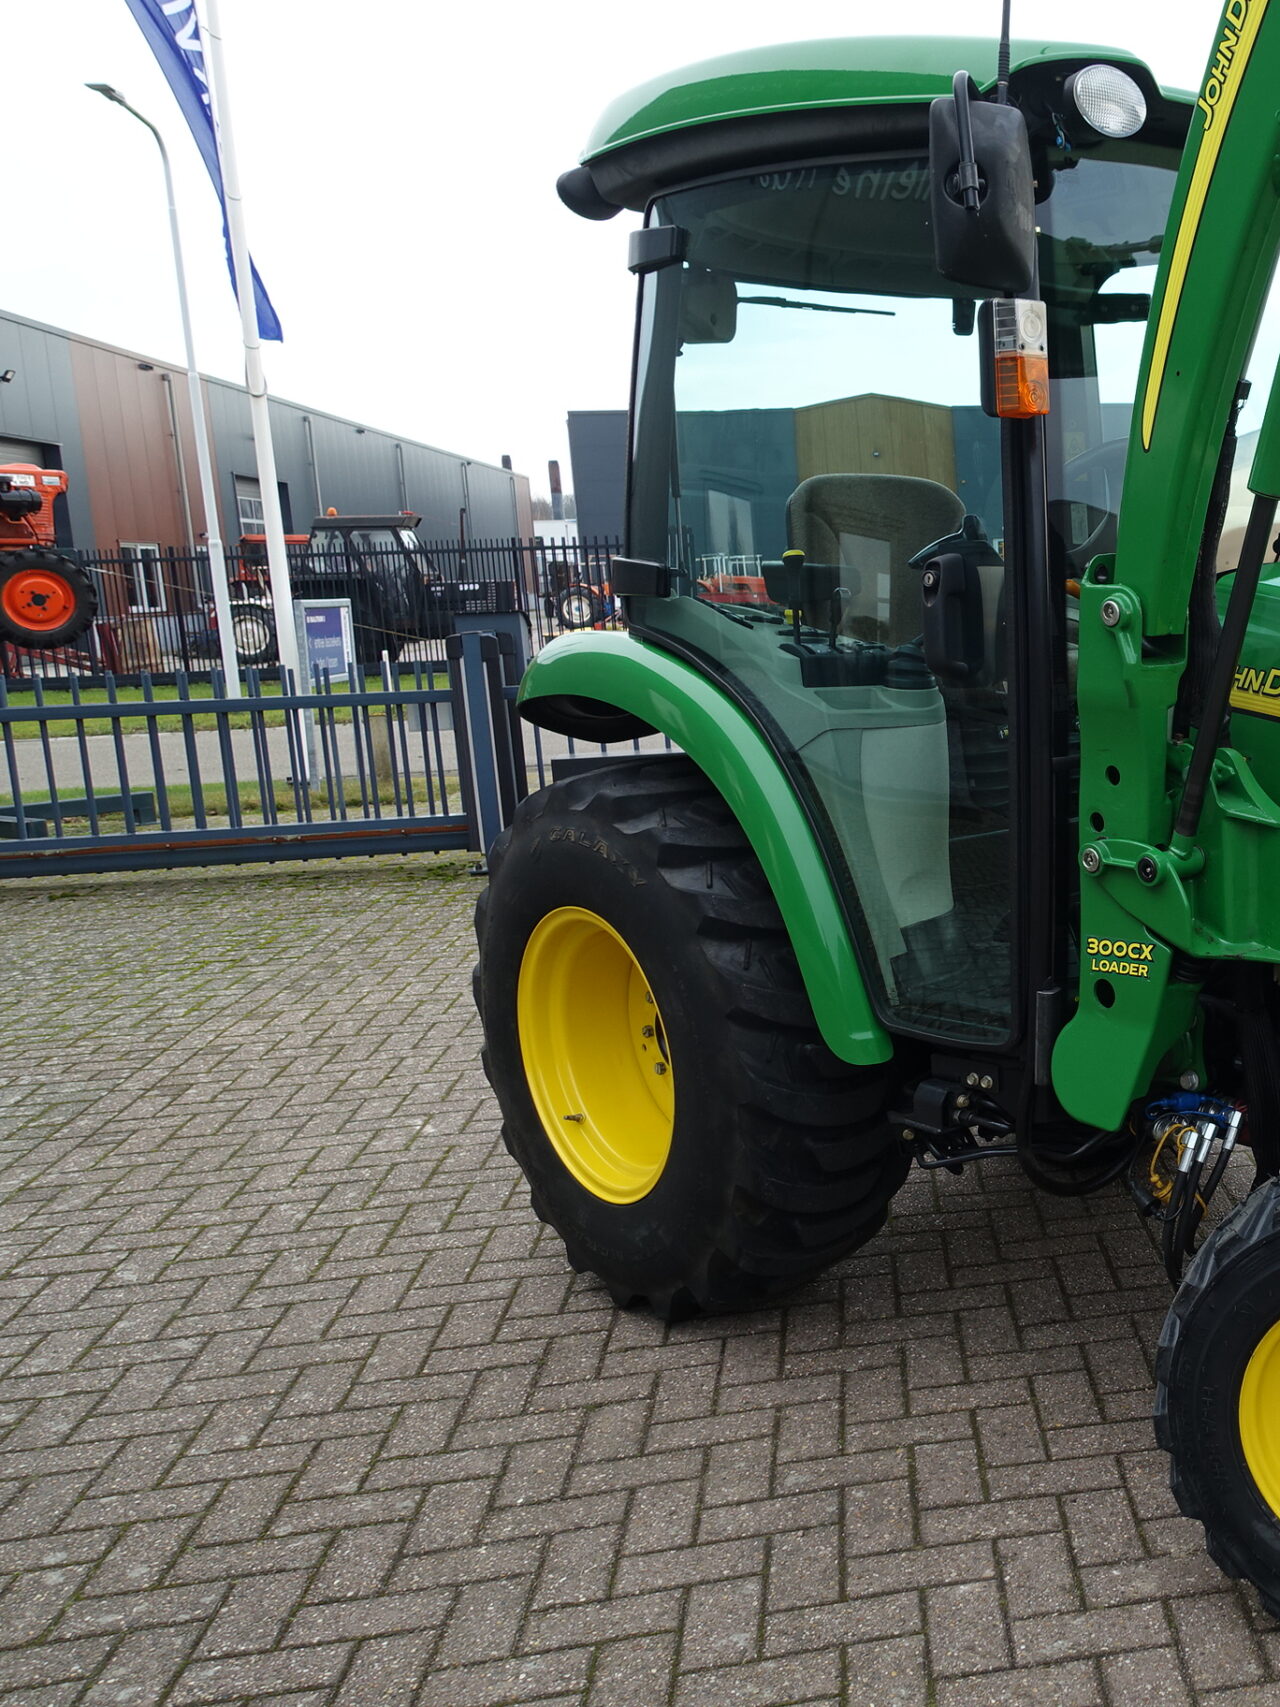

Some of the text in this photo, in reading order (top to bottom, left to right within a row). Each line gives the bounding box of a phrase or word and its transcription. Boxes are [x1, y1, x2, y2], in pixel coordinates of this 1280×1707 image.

[1197, 27, 1238, 131] JOHN
[1086, 937, 1154, 961] 300CX
[1091, 958, 1149, 978] LOADER
